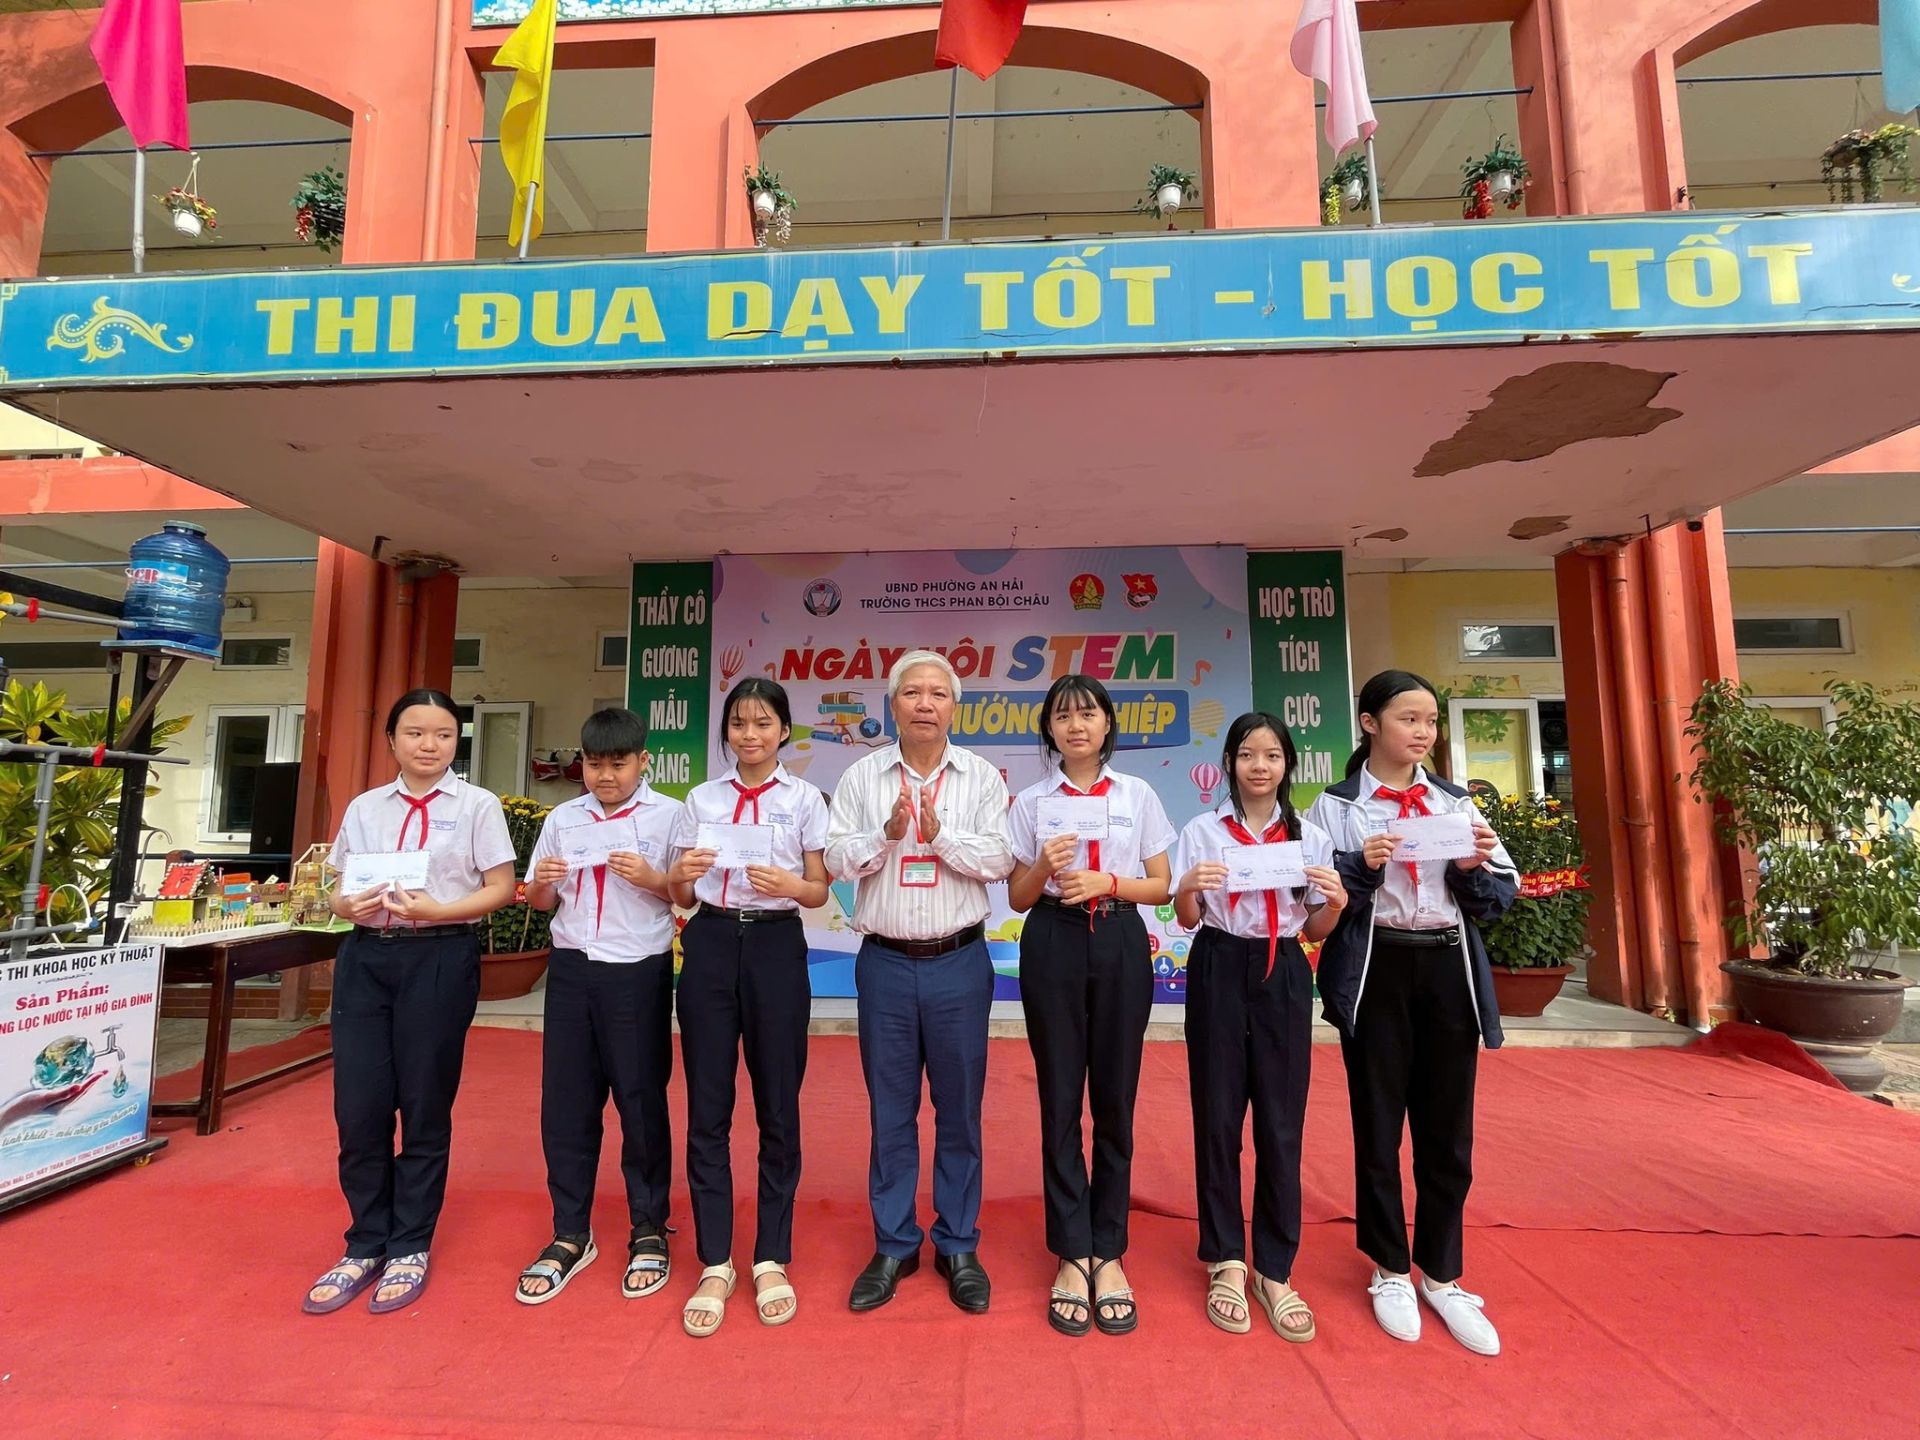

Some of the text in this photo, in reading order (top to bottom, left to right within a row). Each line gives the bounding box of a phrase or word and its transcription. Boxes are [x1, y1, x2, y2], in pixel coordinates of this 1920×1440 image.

[256, 223, 1813, 355] THI ĐUA DẠY TỐT - HỌC TỐT
[860, 593, 1050, 609] TRƯỜNG THCS PHAN BỘI CHÂU
[885, 577, 1024, 593] UBND PHƯỜNG AN HẢI
[1258, 579, 1336, 625] HỌC TRÒ
[638, 586, 706, 626] THẦY CÔ
[642, 645, 698, 678] GƯƠNG
[779, 638, 906, 680] NGÀY
[1007, 635, 1175, 682] STEM
[1279, 634, 1321, 672] TÍCH
[650, 688, 688, 730] MẪU
[1283, 693, 1321, 735] CỰC
[645, 747, 690, 784] SÁNG
[7, 966, 28, 981] THI
[33, 959, 67, 977] KHOA
[72, 955, 97, 972] HỌC
[100, 952, 116, 966] KỸ
[120, 946, 155, 962] THUẬT
[15, 981, 110, 1011] Sản Phẩm:
[18, 1016, 40, 1032] LỌC
[43, 1009, 73, 1026] NƯỚC
[76, 1006, 92, 1020] TẠI
[95, 1001, 109, 1016] HỘ
[111, 998, 127, 1011] GIA
[130, 993, 153, 1007] ĐÌNH
